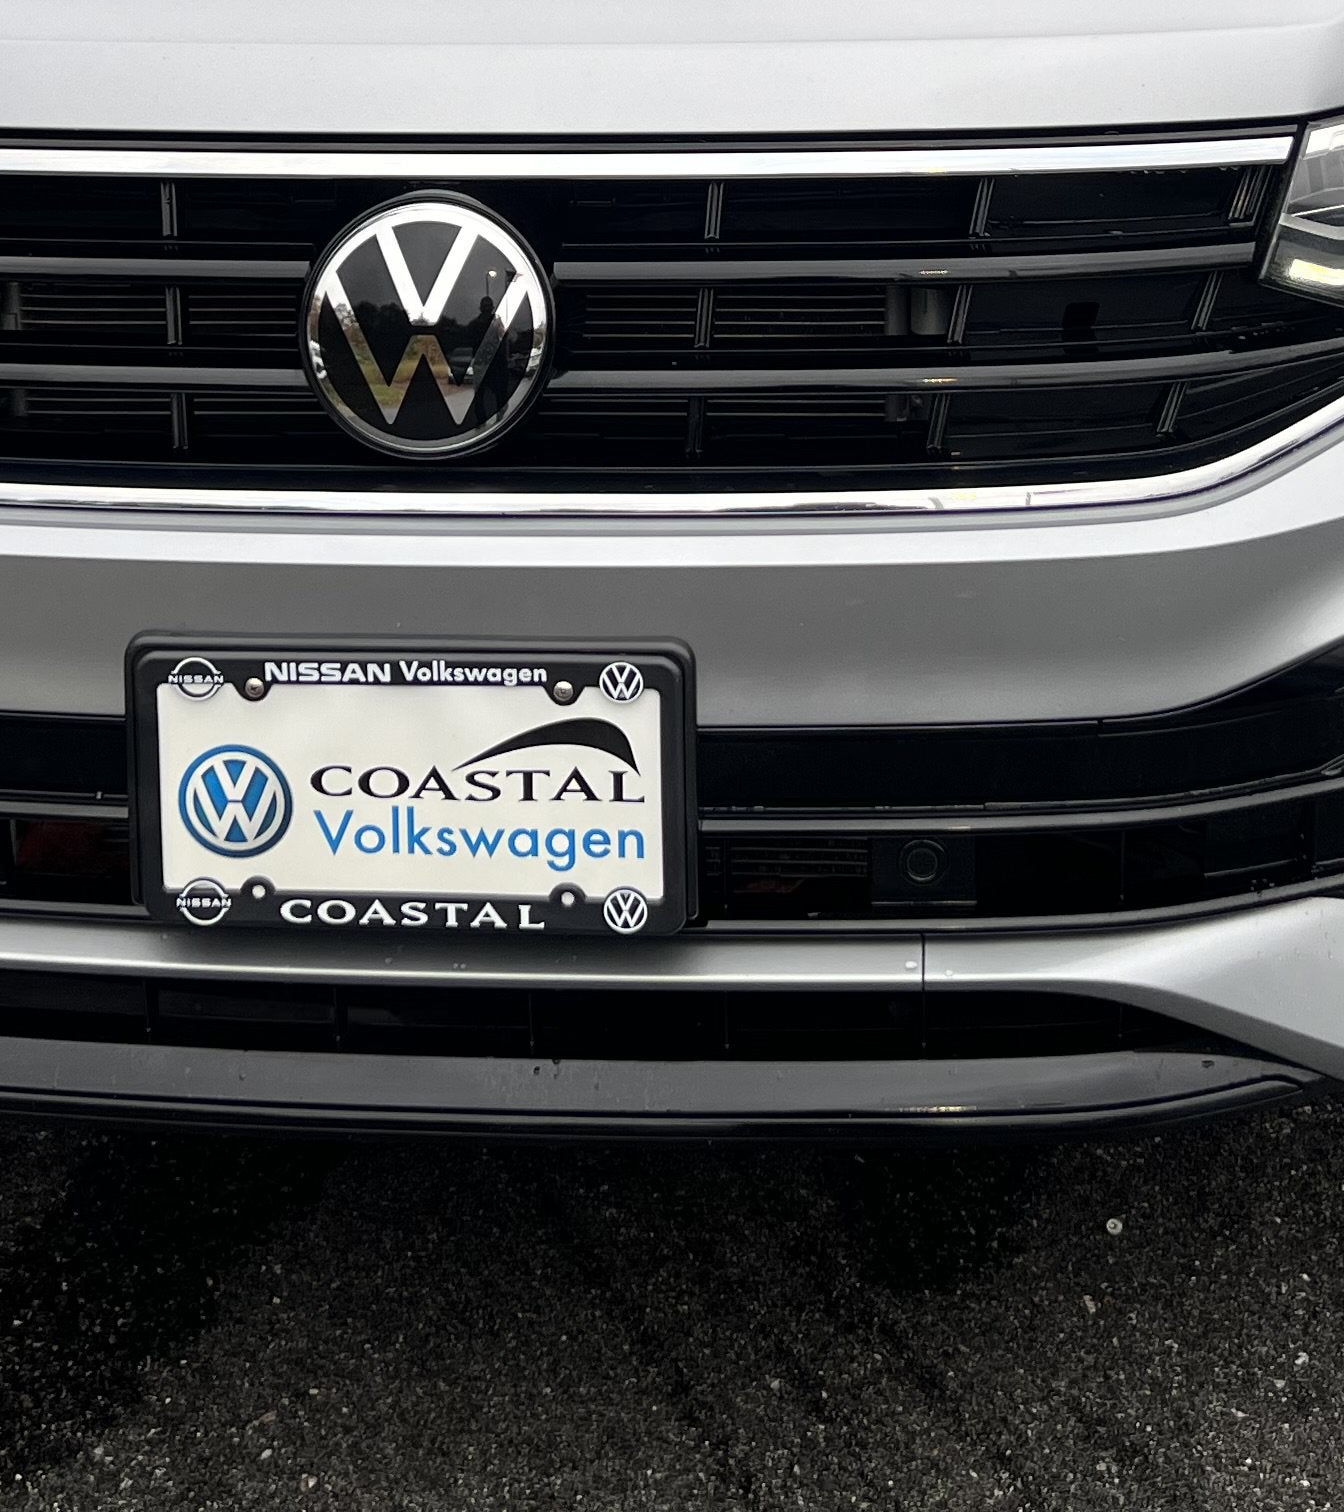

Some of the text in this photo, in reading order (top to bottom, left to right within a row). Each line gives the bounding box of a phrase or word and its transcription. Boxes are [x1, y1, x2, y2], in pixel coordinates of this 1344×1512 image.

[167, 674, 224, 685] NISSAN
[264, 659, 548, 687] NISSAN Volkswagen
[309, 764, 646, 804] COASTAL
[313, 805, 646, 872] Volkswagen
[176, 897, 232, 909] NISSAN
[279, 898, 546, 930] COASTAL
